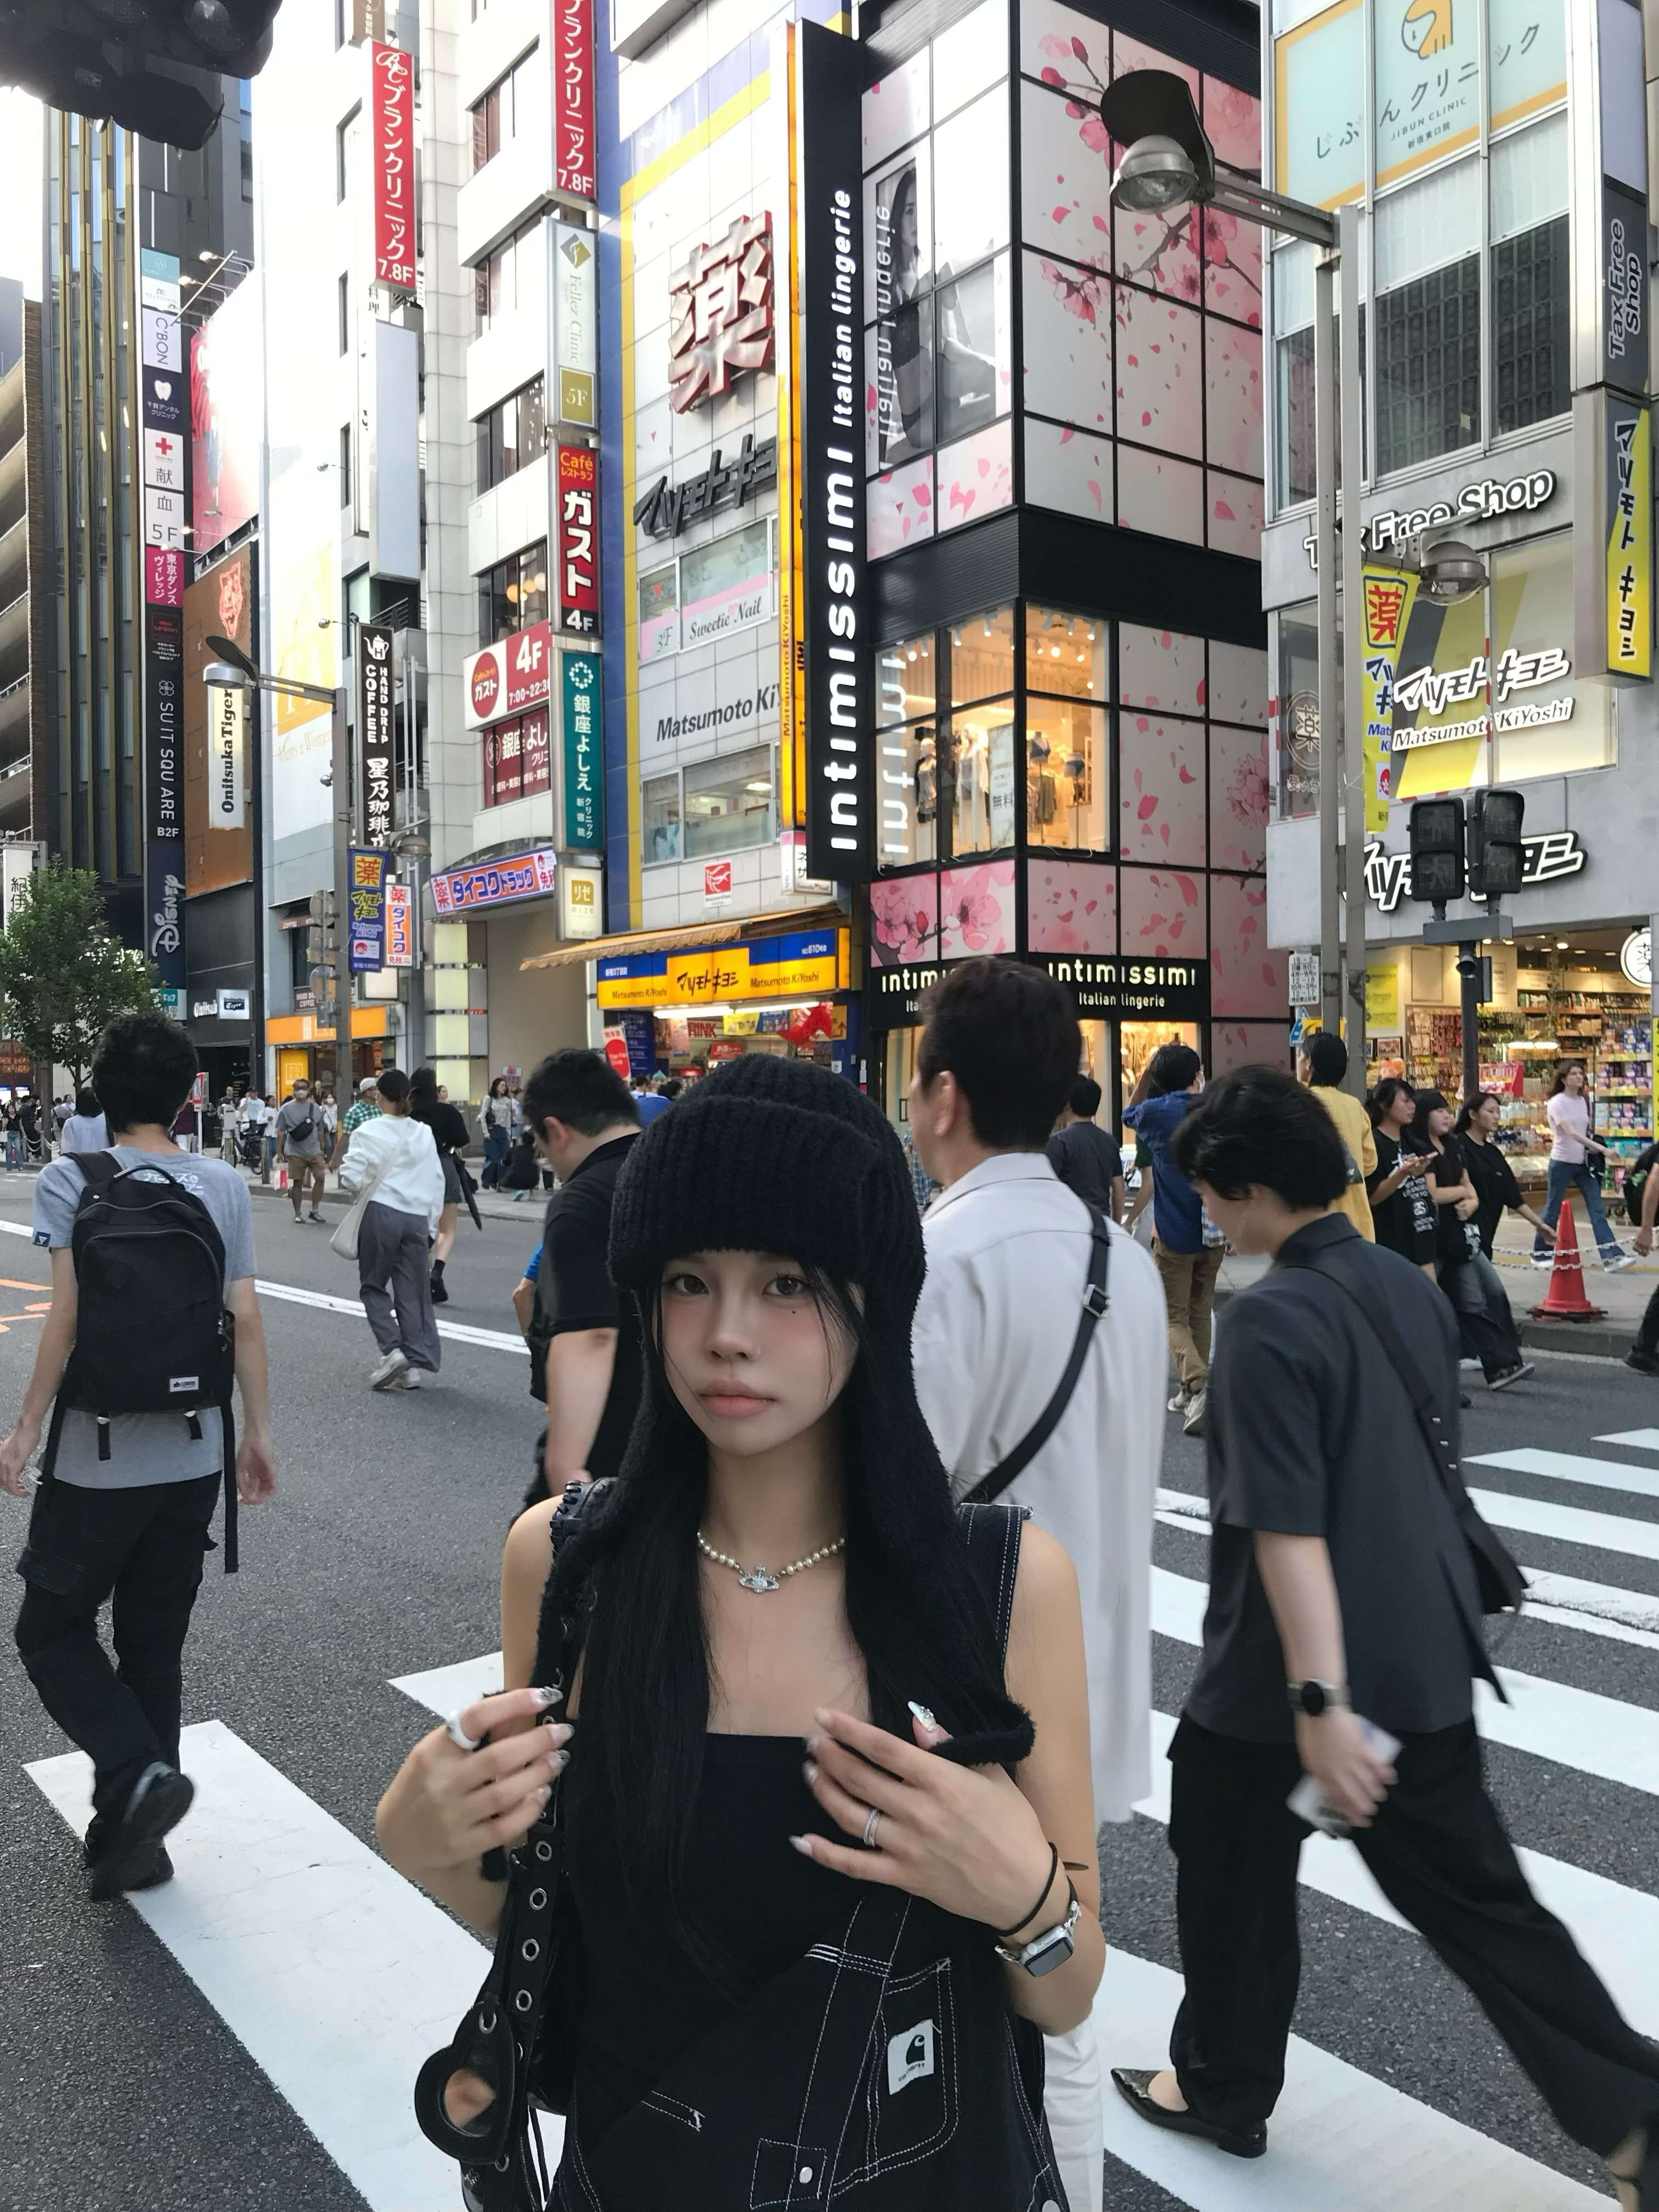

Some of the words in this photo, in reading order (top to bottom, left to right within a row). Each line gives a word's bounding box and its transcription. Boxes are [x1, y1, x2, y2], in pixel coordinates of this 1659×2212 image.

[1390, 117, 1425, 142] JIBUN
[1428, 96, 1468, 122] CLINIC
[383, 83, 406, 261] ブランクリニック
[557, 168, 593, 193] 7.8F
[377, 259, 414, 283] 7.8F
[830, 190, 855, 315] lingerie
[1608, 218, 1626, 292] Free
[570, 274, 582, 317] Fellez
[669, 210, 774, 414] 薬
[1623, 252, 1641, 335] Shop
[156, 317, 169, 365] C'BON
[570, 320, 583, 364] Clinic
[1608, 297, 1626, 360] Tax
[566, 387, 588, 407] 5F
[832, 325, 854, 427] Italian
[151, 409, 176, 420] クリニック
[560, 452, 594, 471] Café
[561, 469, 594, 481] レストラン
[1372, 501, 1455, 551] Free
[1457, 469, 1557, 518] Shop
[153, 523, 178, 542] 5F
[564, 490, 594, 598] ガスト
[1615, 420, 1637, 662] マツモトキヨシ
[154, 556, 165, 599] ヴィレッジ
[166, 553, 177, 605] 東京ダンス
[566, 612, 594, 631] 4F
[689, 613, 731, 640] Sweetie
[733, 596, 763, 623] Nail
[782, 595, 791, 648] KiYoshi
[516, 635, 543, 674] 4F
[824, 448, 858, 851] intimissimi
[380, 667, 389, 704] HAND
[475, 679, 497, 703] ガスト
[1394, 648, 1572, 715] マツモトキヨシ
[159, 702, 174, 742] SUIT
[366, 664, 377, 744] COFFEE
[380, 707, 389, 744] DRIP
[656, 698, 753, 742] Matsumoto
[1393, 716, 1493, 752] Matsumot
[1496, 698, 1573, 732] KiYoshi
[574, 695, 592, 792] 銀座よしえ
[157, 827, 179, 837] B2F
[577, 798, 586, 838] 新宿院
[585, 797, 593, 840] クリニック
[356, 857, 381, 886] 薬
[452, 865, 535, 905] ダイコクドラッグ
[574, 884, 591, 901] リゼ
[392, 906, 407, 954] ダイコク
[612, 990, 645, 1000] Matsumoto
[645, 987, 668, 998] KiYoshi
[676, 968, 739, 997] マツモトキヨシ
[750, 976, 790, 988] Matsumoto
[792, 971, 820, 984] KiYoshi
[1048, 958, 1196, 986] intimissimi
[1079, 992, 1116, 1006] Italian
[1121, 992, 1165, 1009] lingerie
